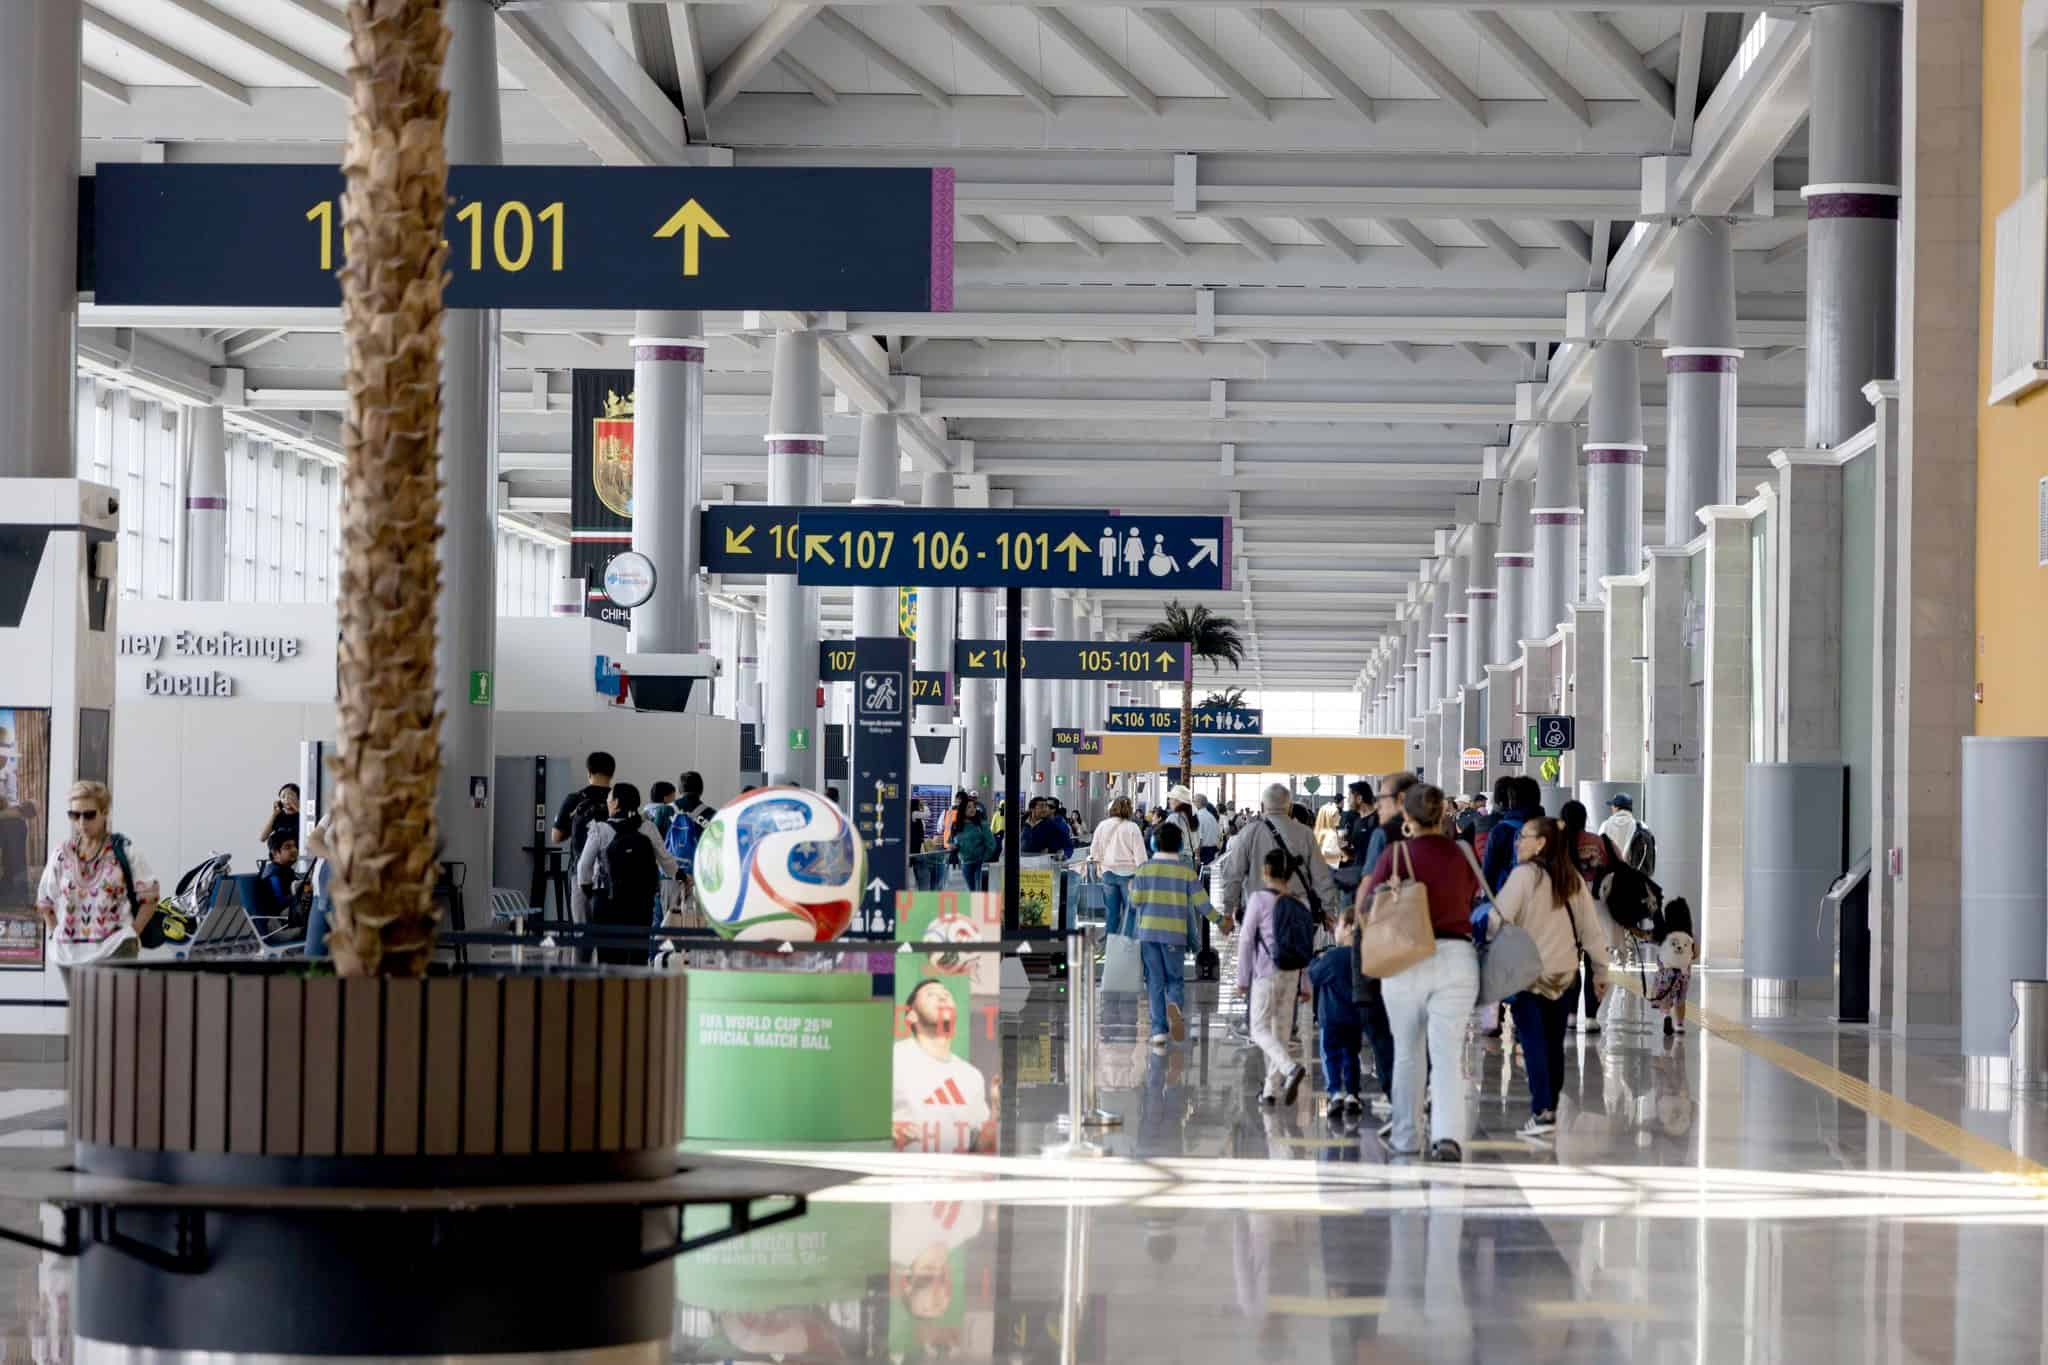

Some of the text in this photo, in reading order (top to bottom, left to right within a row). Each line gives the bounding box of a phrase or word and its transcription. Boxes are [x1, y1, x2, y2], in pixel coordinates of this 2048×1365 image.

[456, 201, 564, 272] 101
[838, 531, 895, 569] 107
[912, 531, 969, 570] 106
[996, 532, 1048, 570] 101
[175, 631, 300, 663] Exchange
[828, 652, 856, 671] 107
[144, 670, 235, 697] Cocula
[1124, 712, 1144, 727] 106
[1150, 713, 1171, 727] 105
[1056, 733, 1079, 743] 106 B
[726, 1015, 771, 1031] WORLD
[774, 1017, 801, 1032] CUP
[753, 1032, 799, 1049] MATCH
[801, 1034, 832, 1051] BALL
